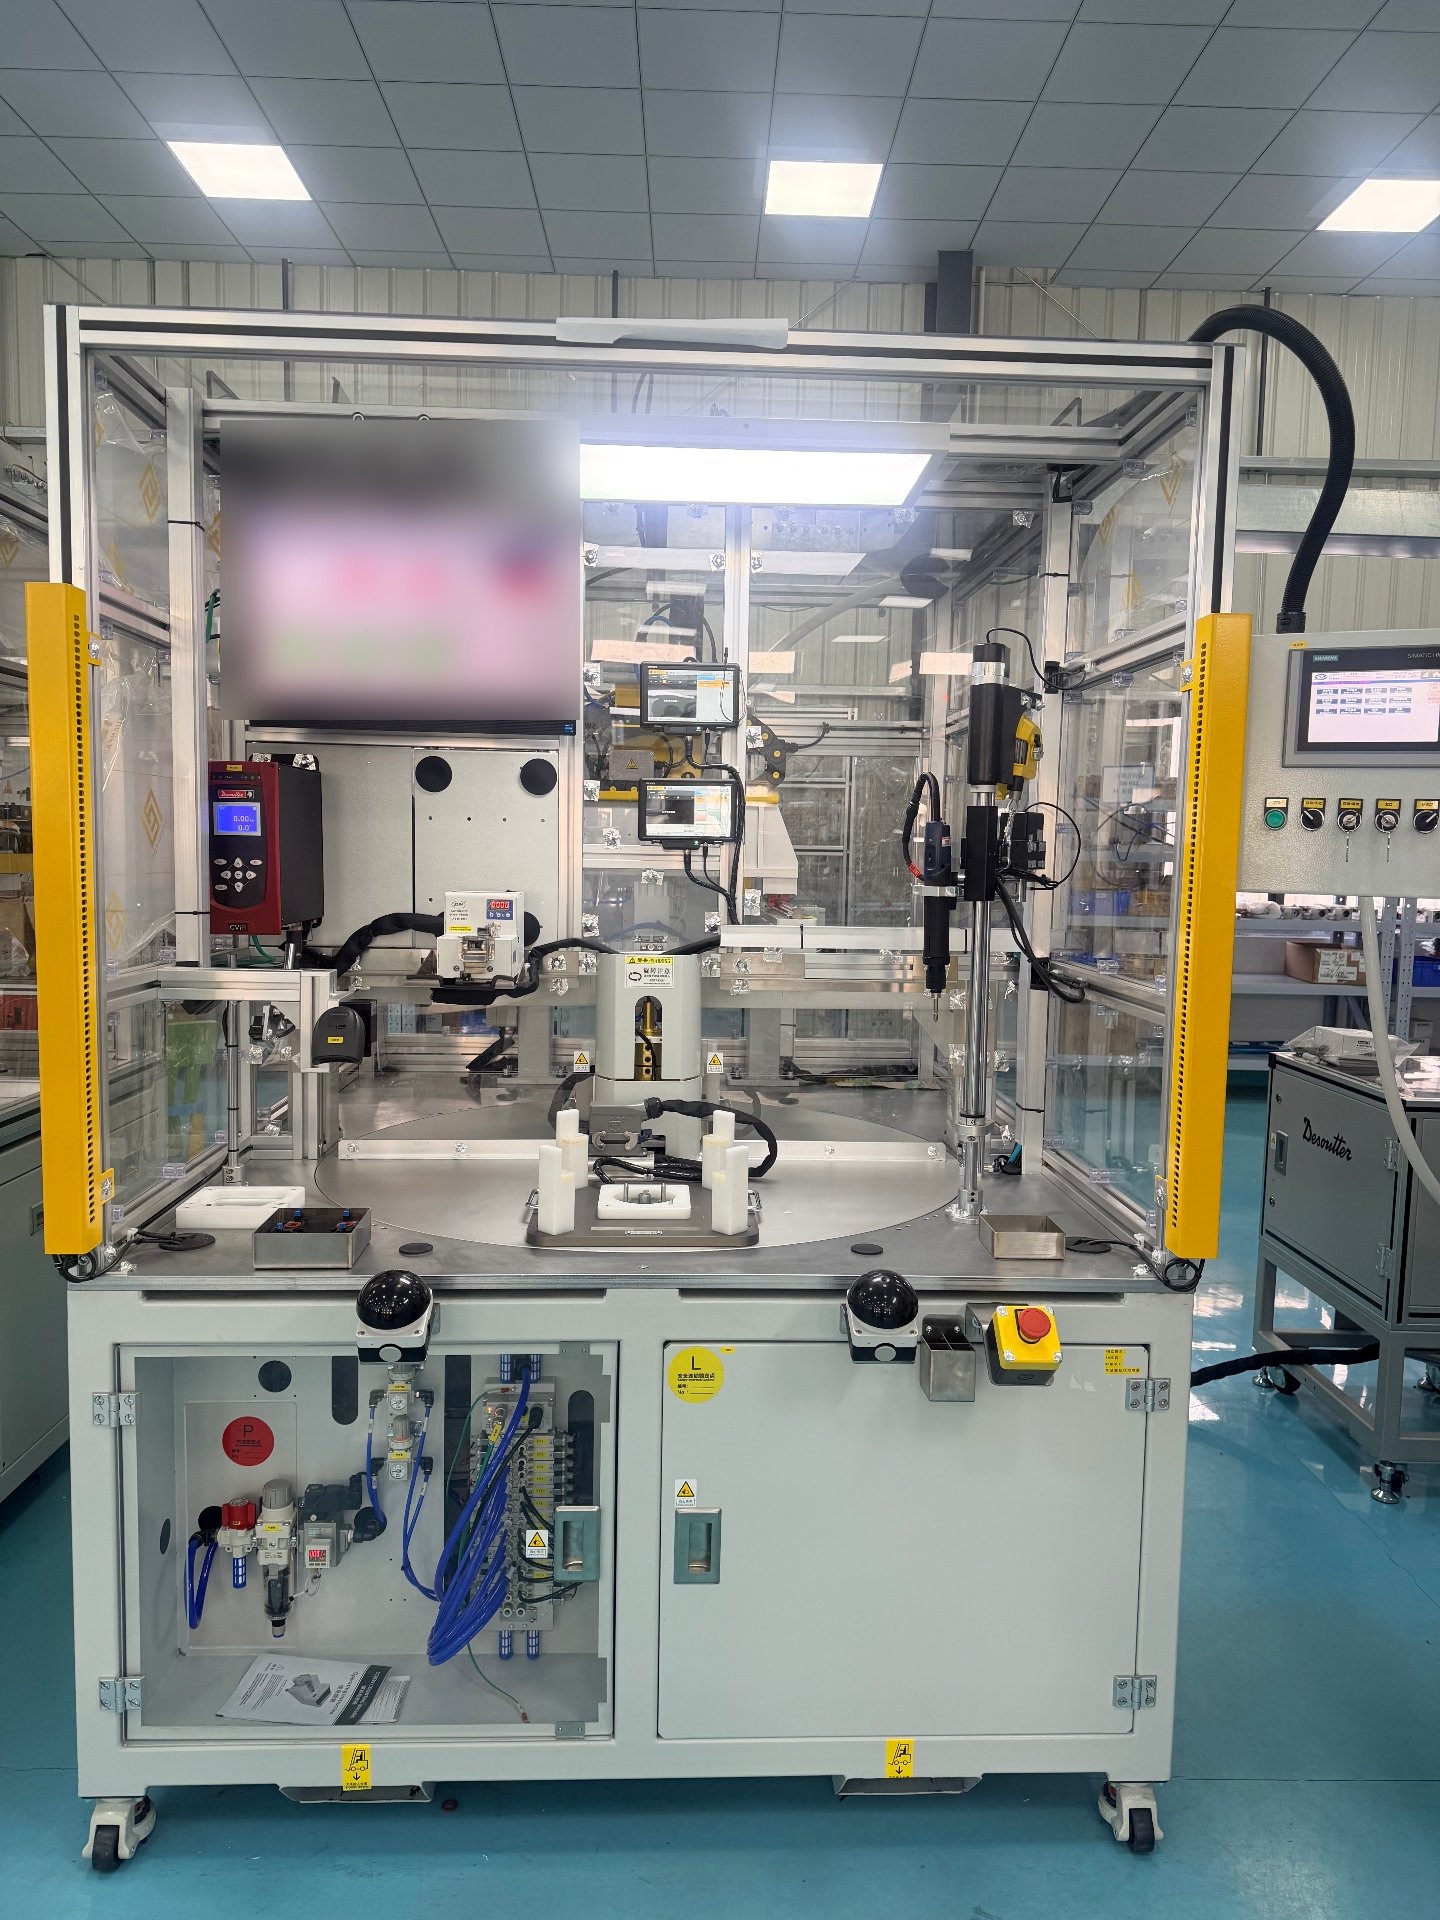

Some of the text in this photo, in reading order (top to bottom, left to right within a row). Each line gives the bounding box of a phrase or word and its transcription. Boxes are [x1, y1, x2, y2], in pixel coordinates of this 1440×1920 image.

[1303, 1116, 1352, 1161] Desoutter
[692, 1356, 701, 1369] L
[243, 1424, 254, 1437] P
